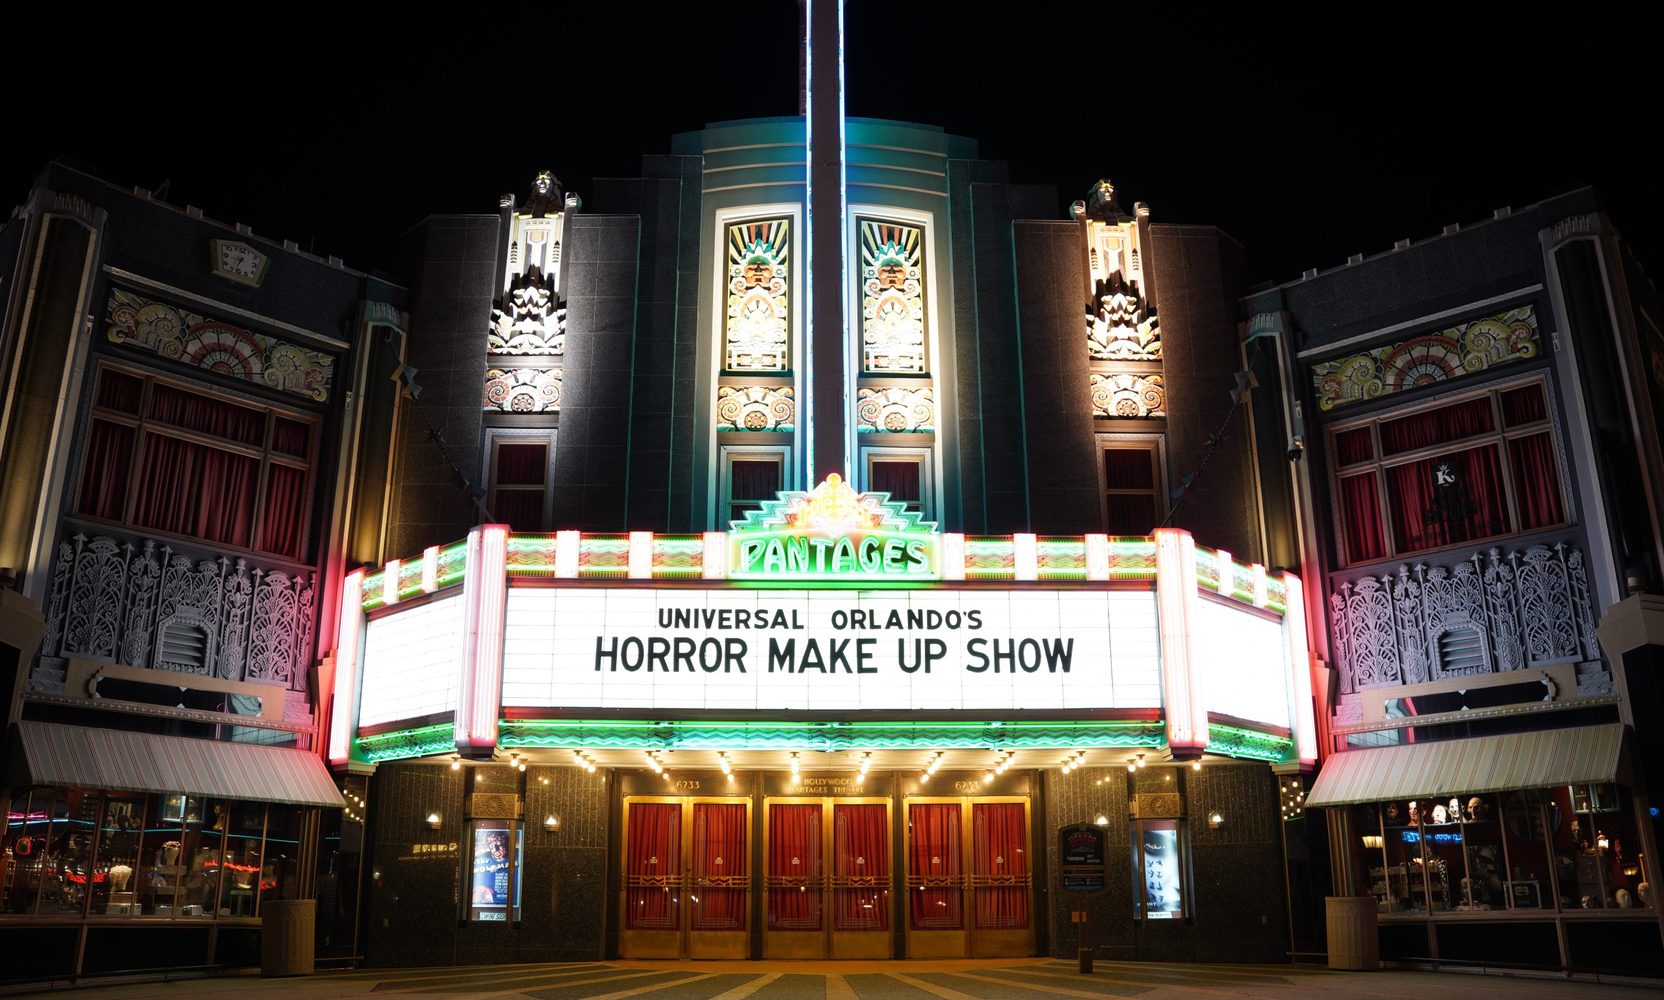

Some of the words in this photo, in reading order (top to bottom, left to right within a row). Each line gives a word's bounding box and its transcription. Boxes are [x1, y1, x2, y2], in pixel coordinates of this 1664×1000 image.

[740, 535, 929, 574] PANTAGES
[658, 608, 804, 630] UNIVERSAL
[831, 608, 982, 630] ORLANDO'S
[594, 636, 748, 673] HORROR
[768, 637, 878, 674] MAKE
[898, 638, 947, 674] UP
[966, 637, 1074, 674] SHOW
